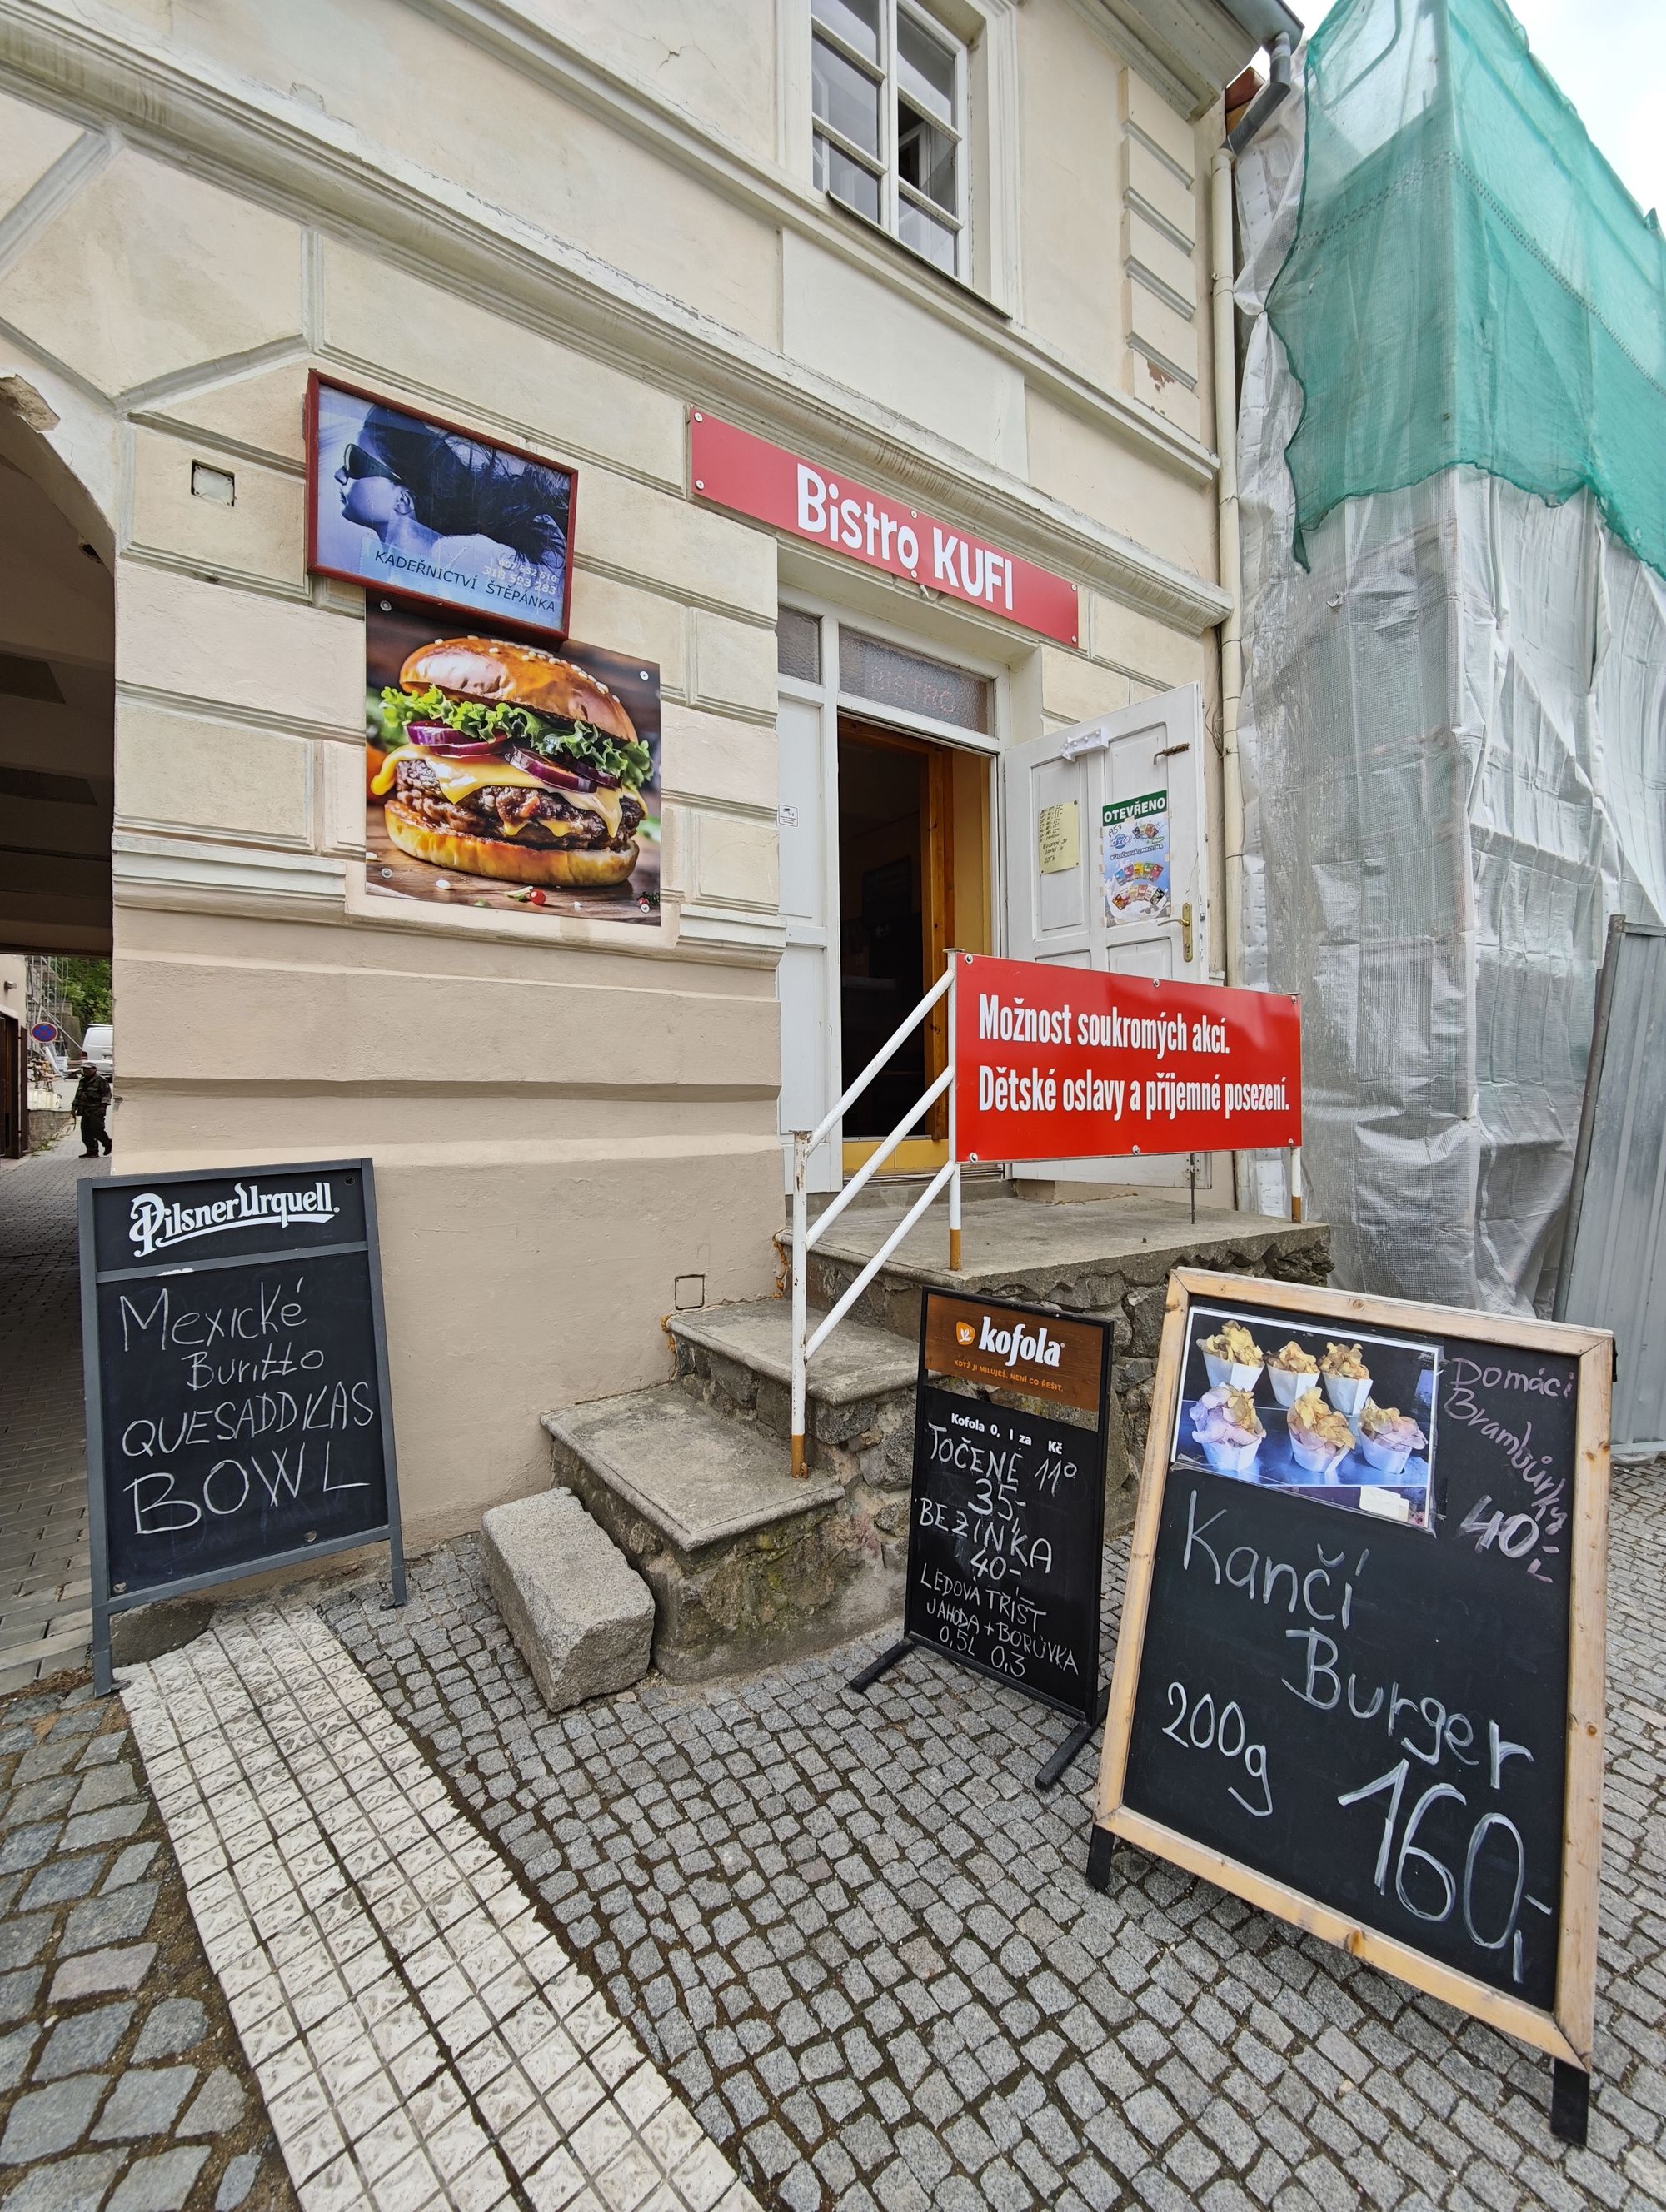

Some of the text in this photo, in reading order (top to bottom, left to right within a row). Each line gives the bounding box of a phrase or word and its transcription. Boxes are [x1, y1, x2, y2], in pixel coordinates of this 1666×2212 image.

[796, 463, 1013, 610] Bistro KUFI
[374, 550, 556, 612] KADEŘNICTVÍ ŠTĚPÁNKA
[1104, 797, 1166, 823] OTEVŘENO
[978, 993, 1230, 1060] Možnost soukromých akcí.
[978, 1064, 1290, 1122] Dětské oslavy a příjemné posezení.
[129, 1193, 240, 1258] Pilsner
[120, 1276, 307, 1352] Mexické
[978, 1316, 1060, 1368] kofola
[954, 1359, 971, 1369] KDYŽ
[1010, 1373, 1027, 1382] NENÍ
[1029, 1378, 1040, 1386] CO
[1041, 1381, 1064, 1392] ŘEŠIT.
[951, 1413, 985, 1432] Kofola
[1019, 1434, 1032, 1446] za
[1048, 1440, 1063, 1455] Kč
[123, 1441, 372, 1535] BOWL
[1183, 1489, 1370, 1631] Kančí
[1281, 1626, 1534, 1790] Burger
[1161, 1681, 1274, 1817] 200g
